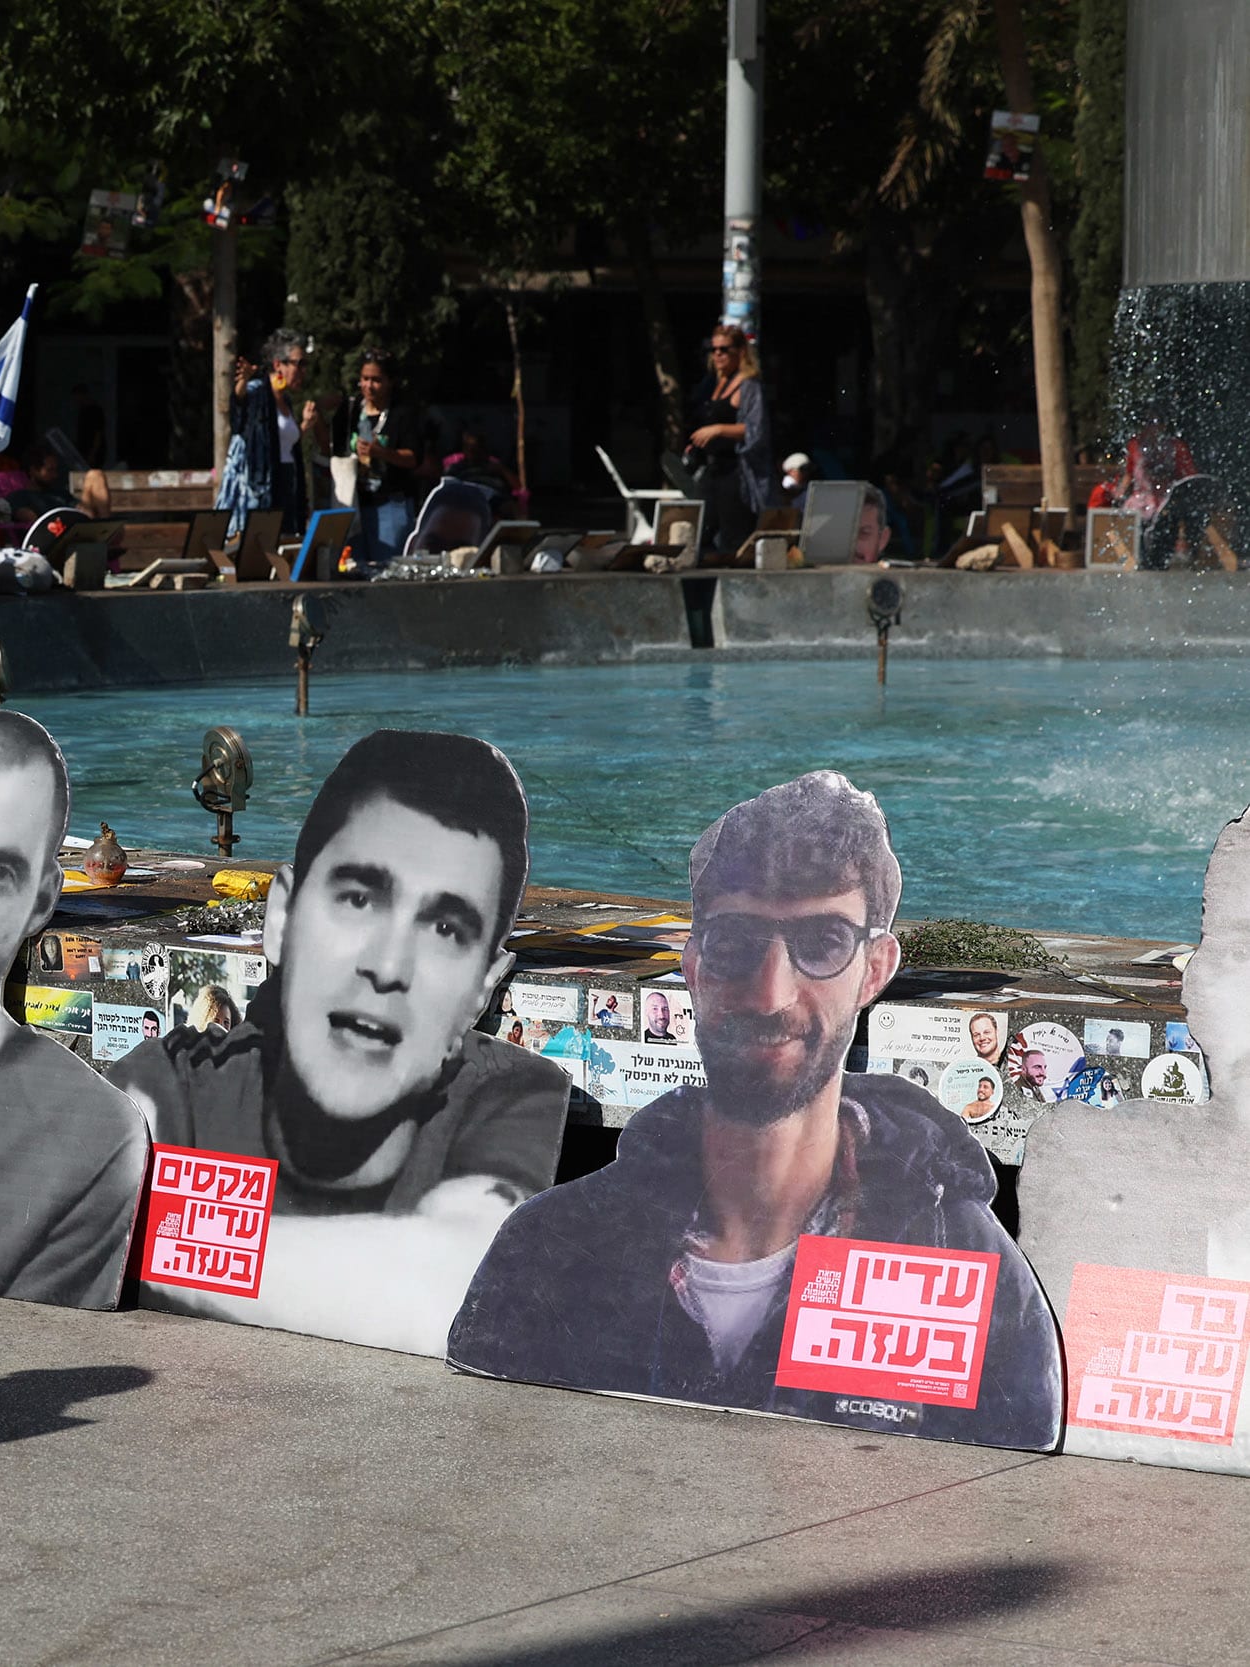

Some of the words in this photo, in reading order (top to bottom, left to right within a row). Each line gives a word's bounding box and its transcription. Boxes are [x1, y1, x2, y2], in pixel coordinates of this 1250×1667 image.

[98, 1013, 120, 1023] לקטוף
[109, 1023, 127, 1033] פרחי
[128, 1025, 139, 1034] את
[631, 1053, 654, 1068] שלך
[664, 1072, 678, 1084] לא
[157, 1157, 266, 1201] מקסים
[187, 1203, 260, 1239] עדיין
[163, 1243, 252, 1283] בעזה.
[818, 1269, 842, 1279] מחאת
[852, 1257, 980, 1308] עדיין
[1175, 1293, 1237, 1334] בר
[810, 1317, 967, 1374] בעזה.
[1128, 1334, 1234, 1378] עדיין
[1094, 1383, 1223, 1429] בעזה.
